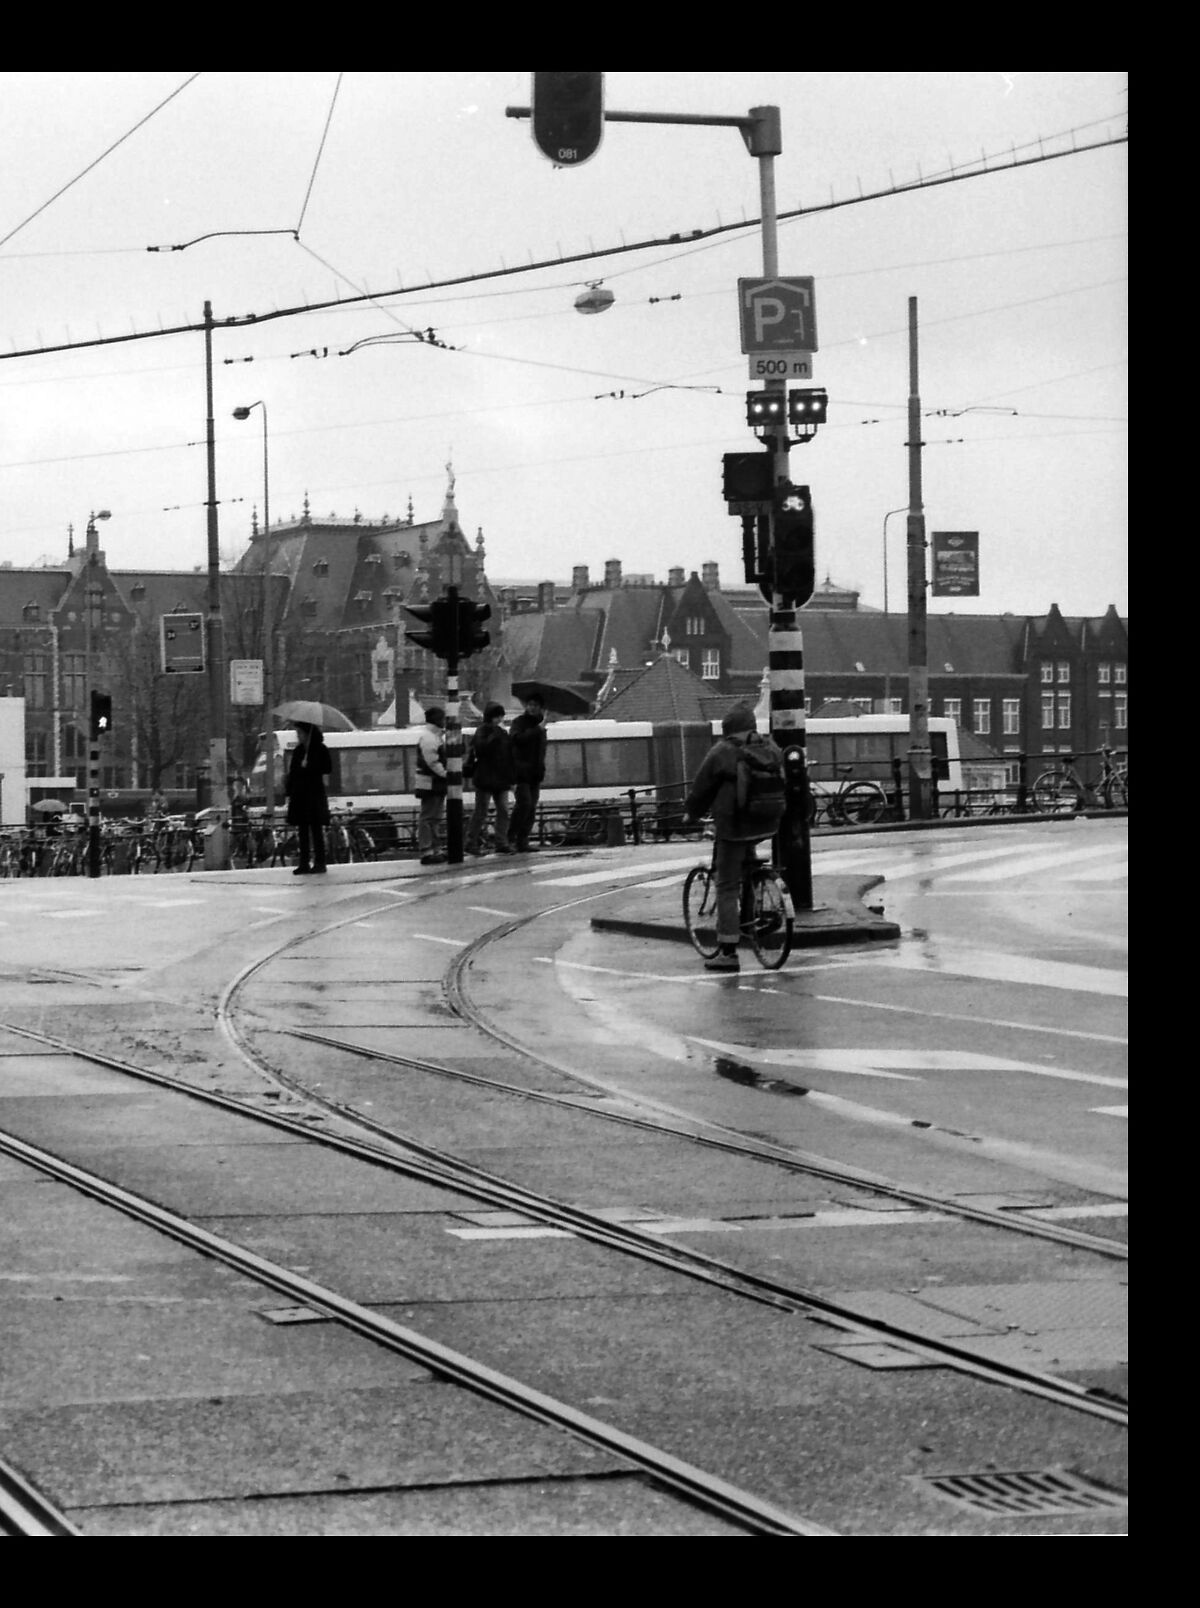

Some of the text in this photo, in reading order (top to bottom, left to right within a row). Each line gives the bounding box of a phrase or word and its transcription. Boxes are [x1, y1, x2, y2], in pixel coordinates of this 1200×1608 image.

[754, 297, 785, 342] P
[756, 360, 808, 374] 500 m
